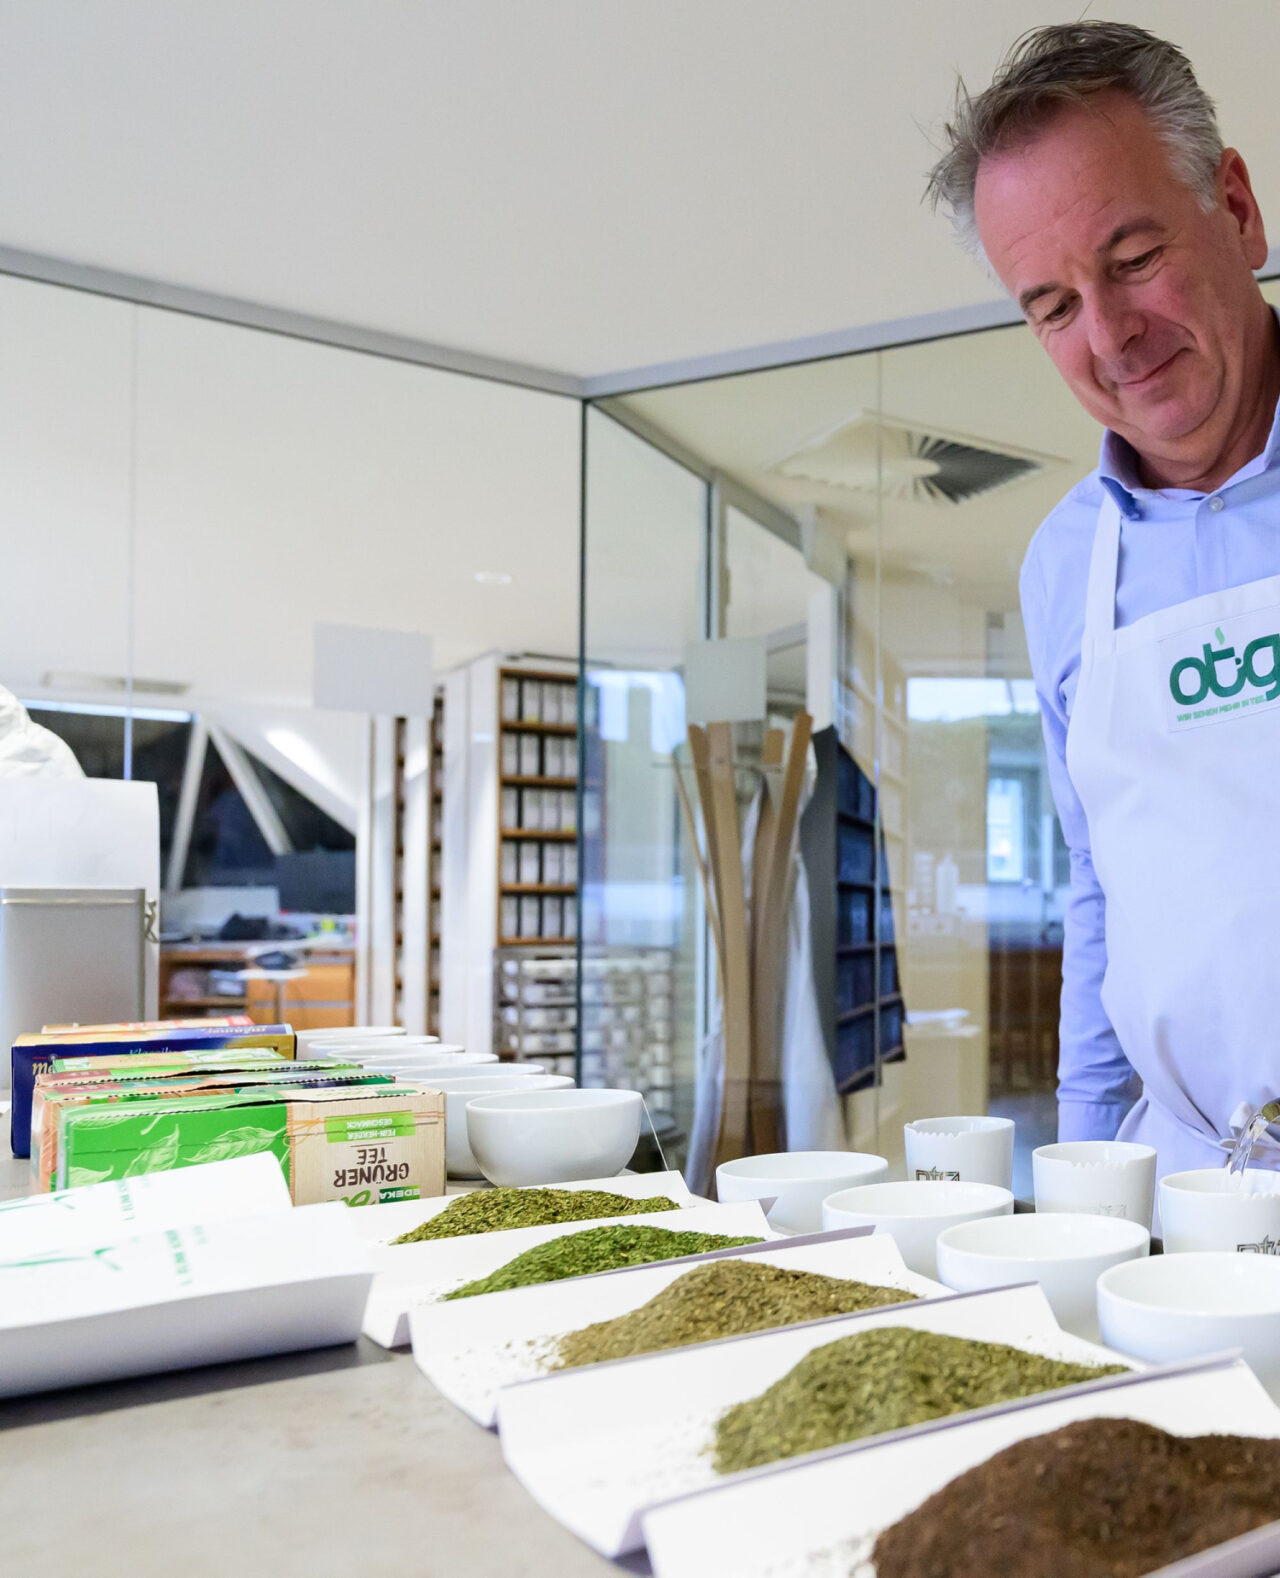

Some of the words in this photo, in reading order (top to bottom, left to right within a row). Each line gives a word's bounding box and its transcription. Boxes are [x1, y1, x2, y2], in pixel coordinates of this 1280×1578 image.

[356, 1147, 388, 1165] TEE
[333, 1162, 410, 1188] GRÜNER
[380, 1188, 420, 1200] EDEKA
